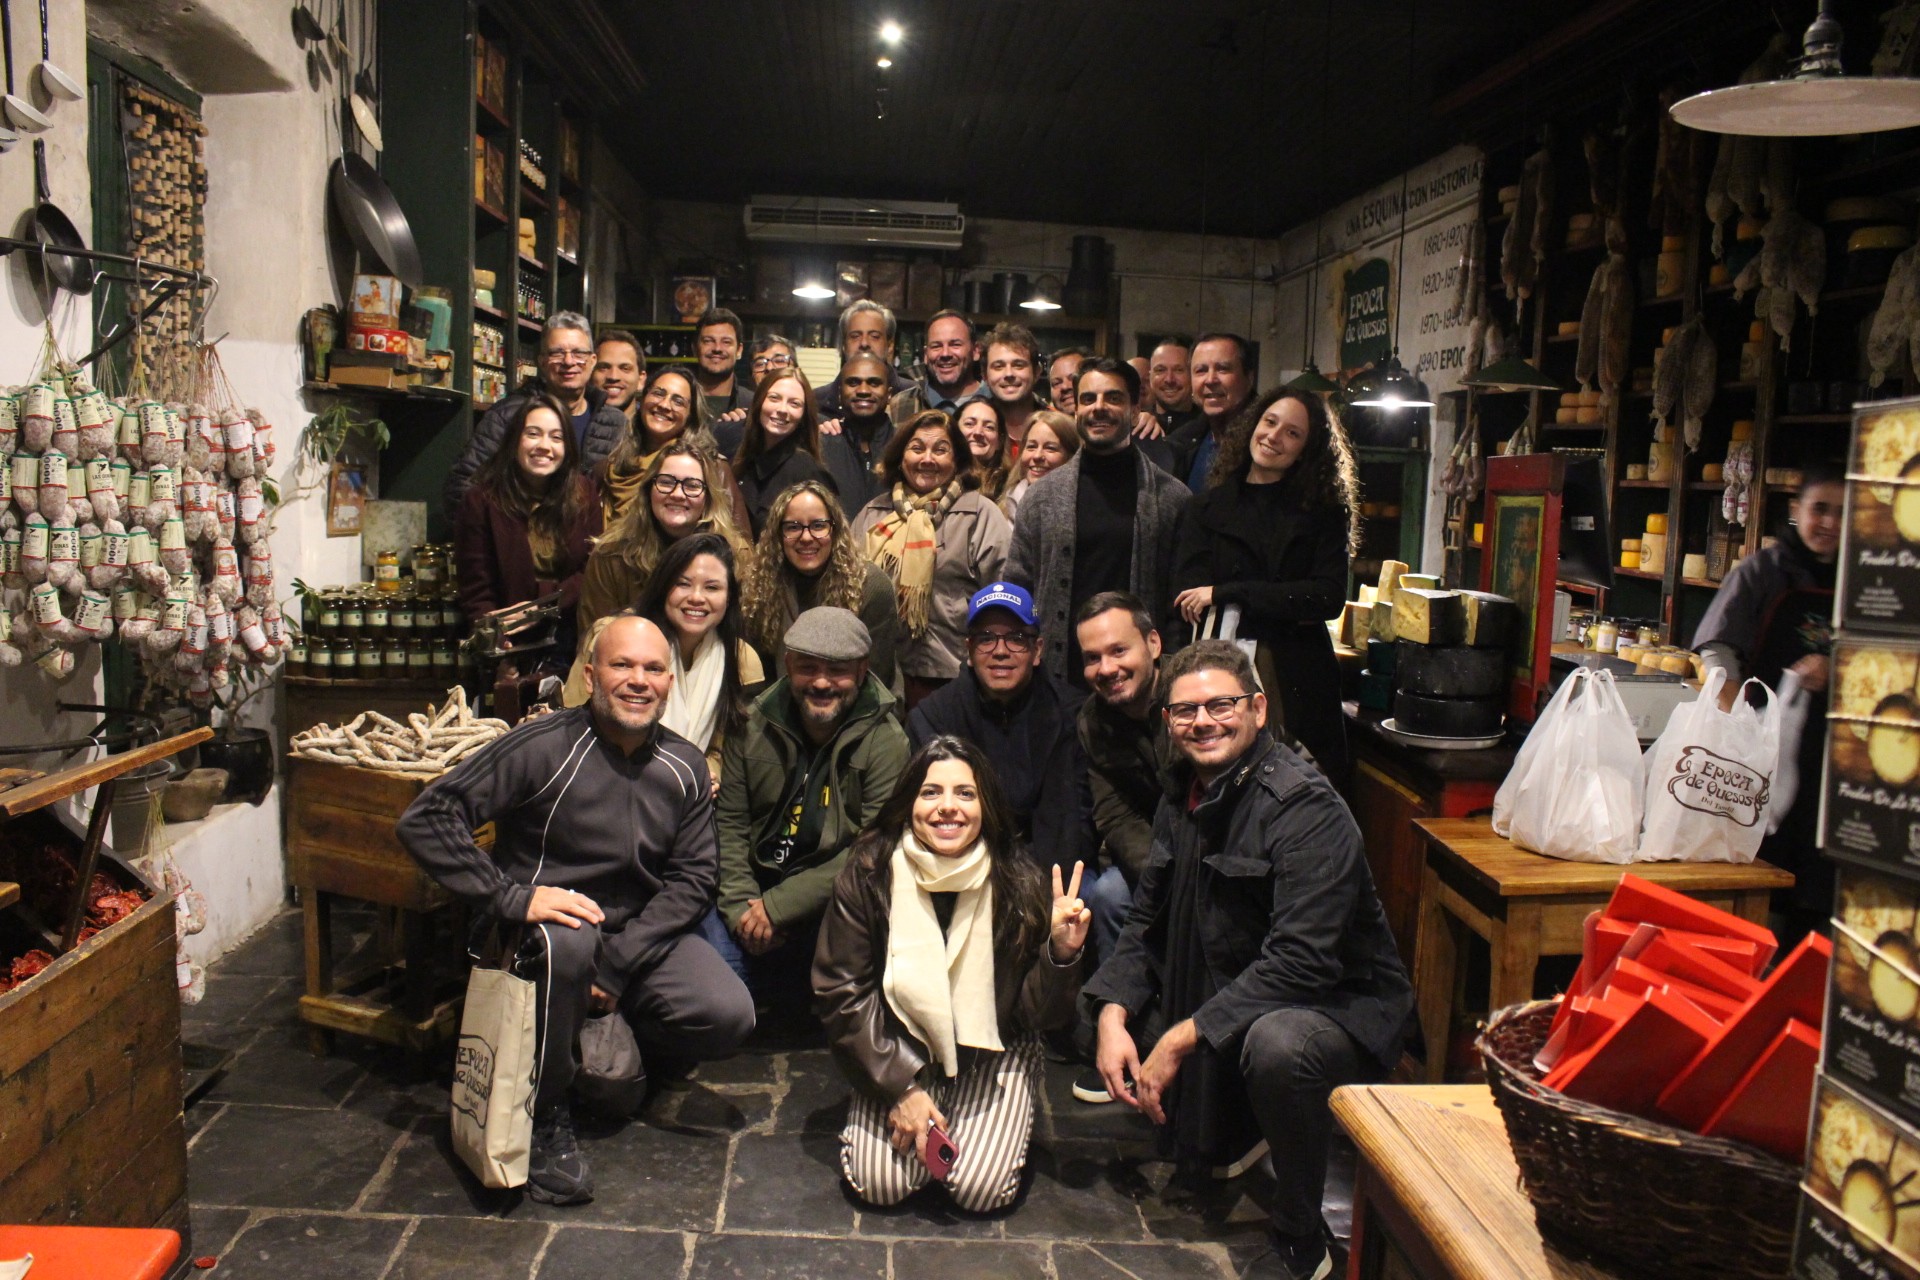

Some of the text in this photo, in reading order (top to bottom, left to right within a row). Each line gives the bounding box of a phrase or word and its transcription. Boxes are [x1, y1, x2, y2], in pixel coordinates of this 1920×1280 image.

[1362, 192, 1408, 229] ESQUINA
[1409, 184, 1428, 210] CON
[1430, 160, 1480, 200] HISTORIA
[1421, 266, 1459, 296] 1920-197
[1349, 286, 1385, 320] EPOCA
[1345, 324, 1356, 343] de
[1440, 346, 1466, 370] EPOC
[977, 592, 1021, 606] NACIONAL
[1685, 774, 1756, 807] de Quesos
[1700, 760, 1755, 791] EPOCA
[457, 1046, 489, 1078] EPOCA
